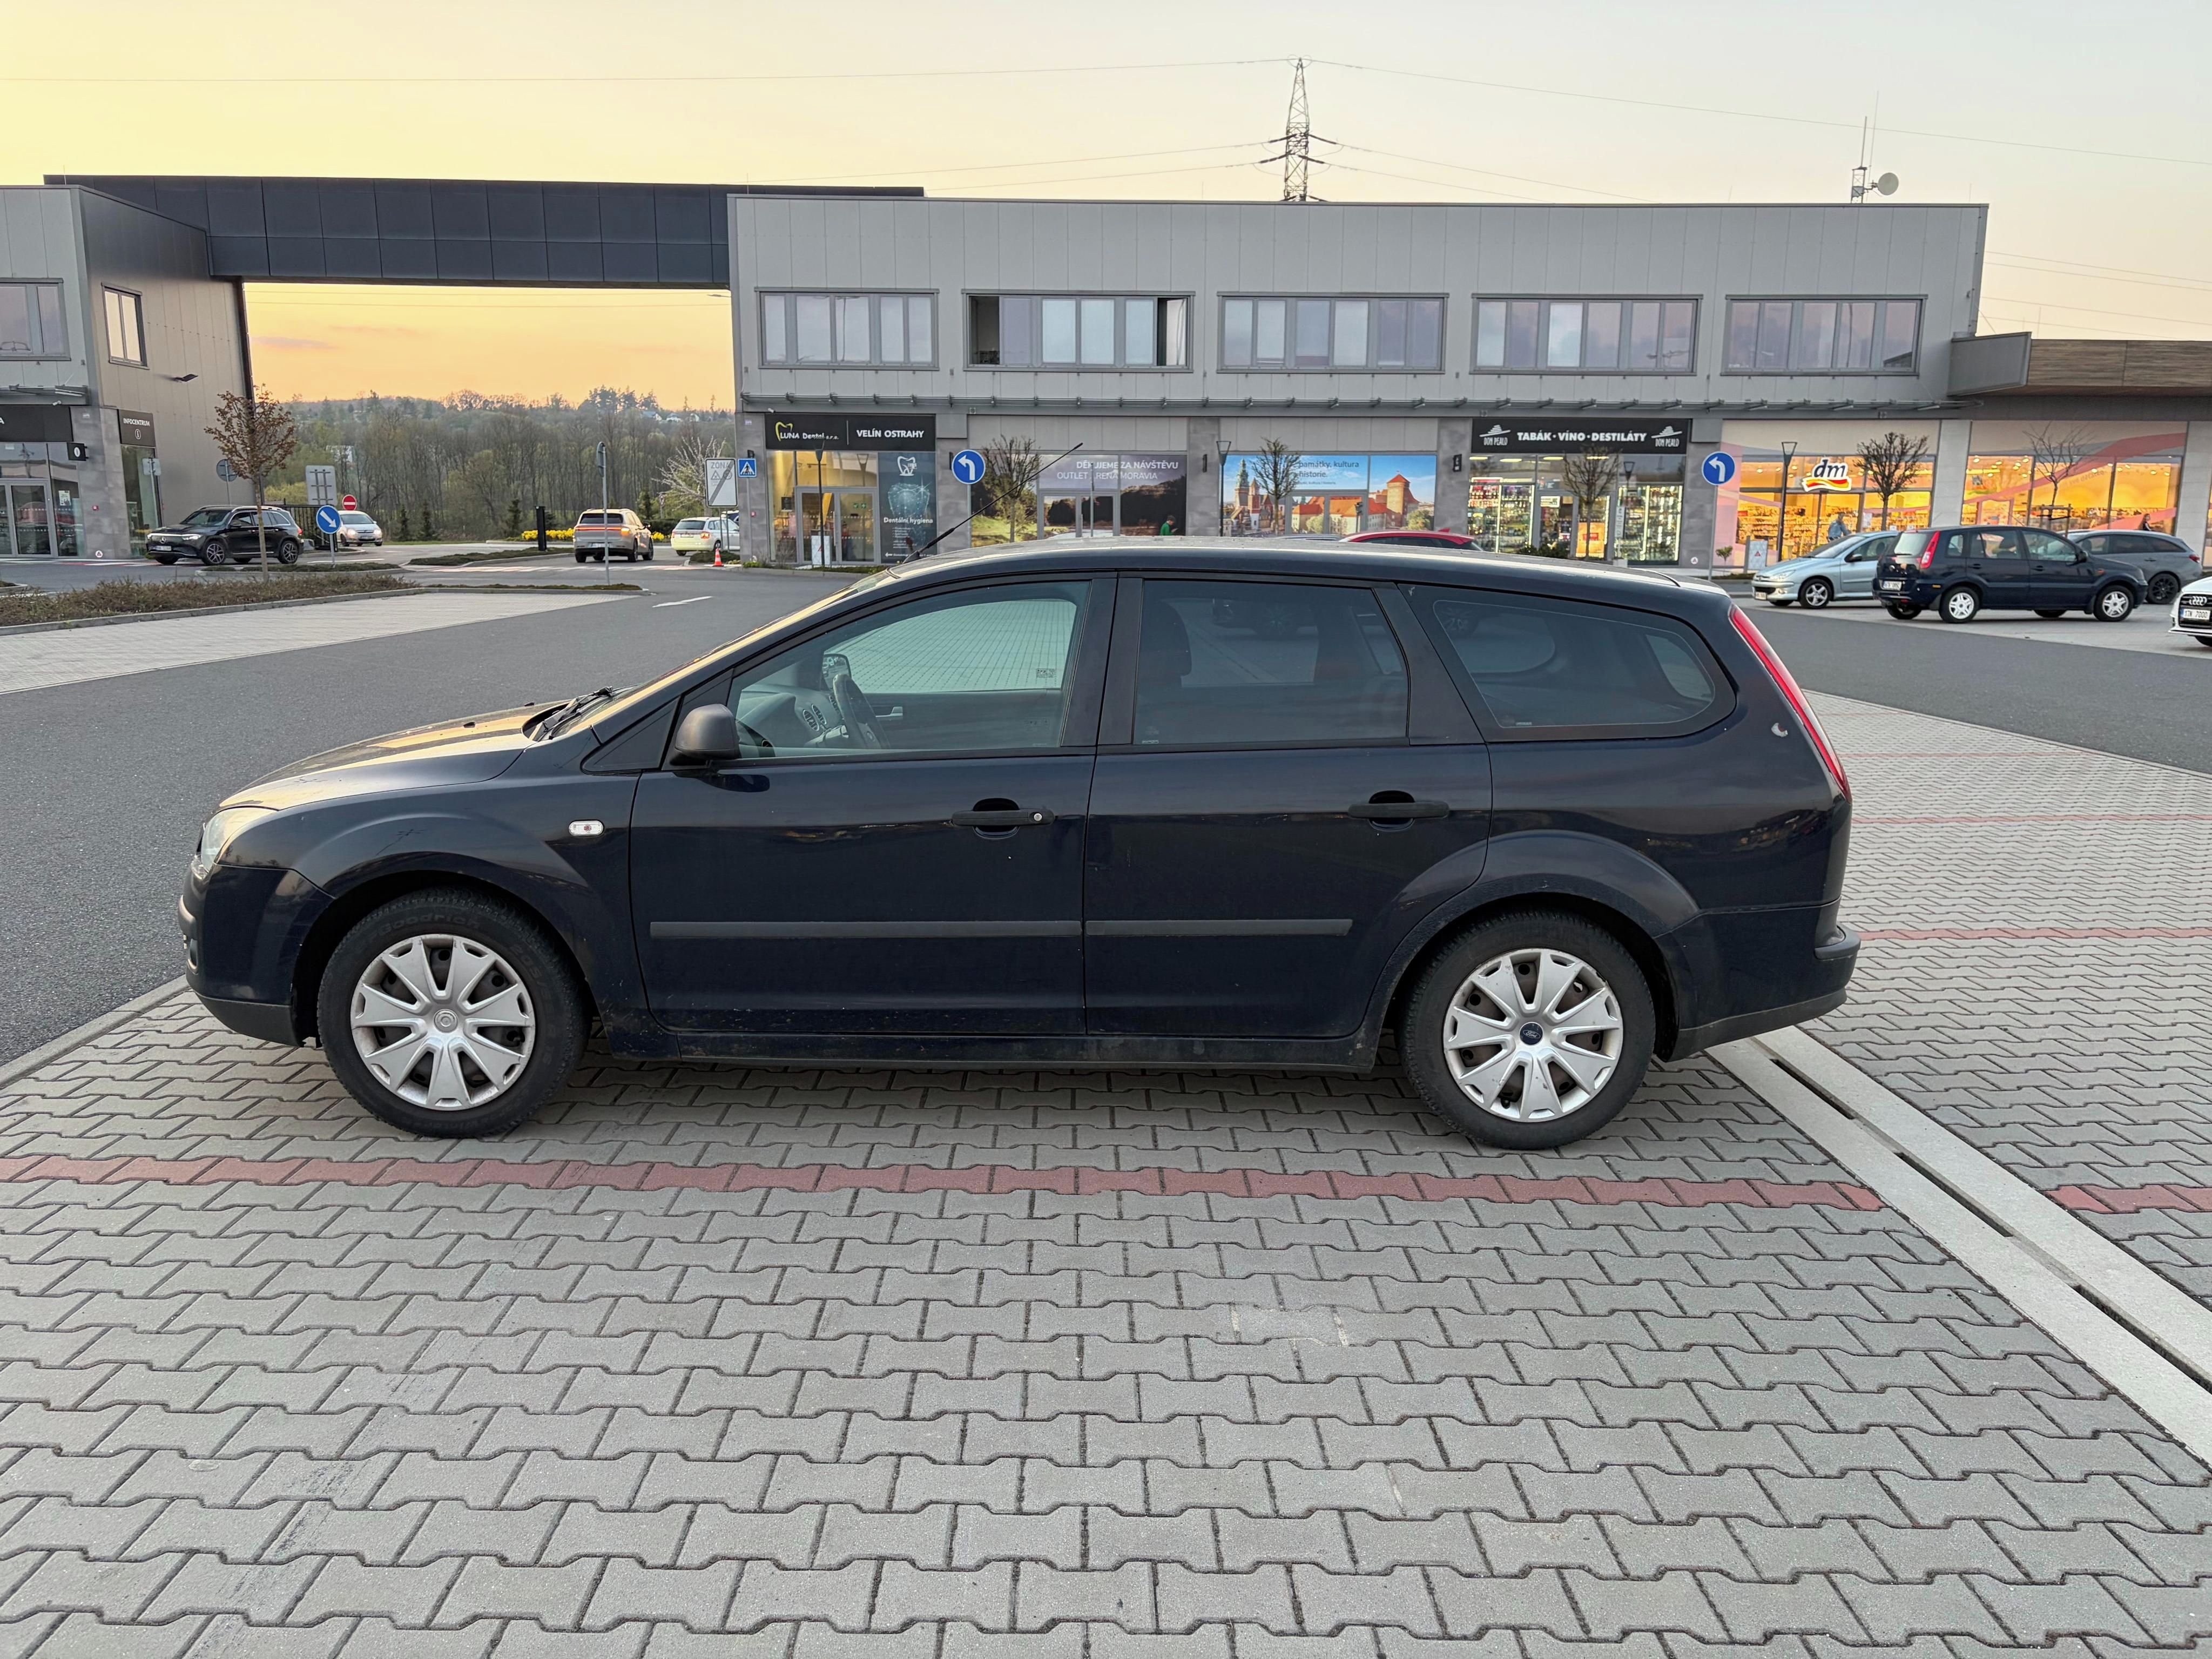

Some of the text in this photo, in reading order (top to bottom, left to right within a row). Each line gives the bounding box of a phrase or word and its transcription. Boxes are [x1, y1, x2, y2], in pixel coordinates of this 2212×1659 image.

[123, 418, 150, 427] INFOCENTRUM
[856, 428, 924, 438] VELÍN OSTRAHY
[1517, 429, 1647, 442] TABÁK VÍNO DESTILÁTY
[1134, 460, 1178, 469] NÁVŠTĚVU
[1814, 459, 1846, 478] dm
